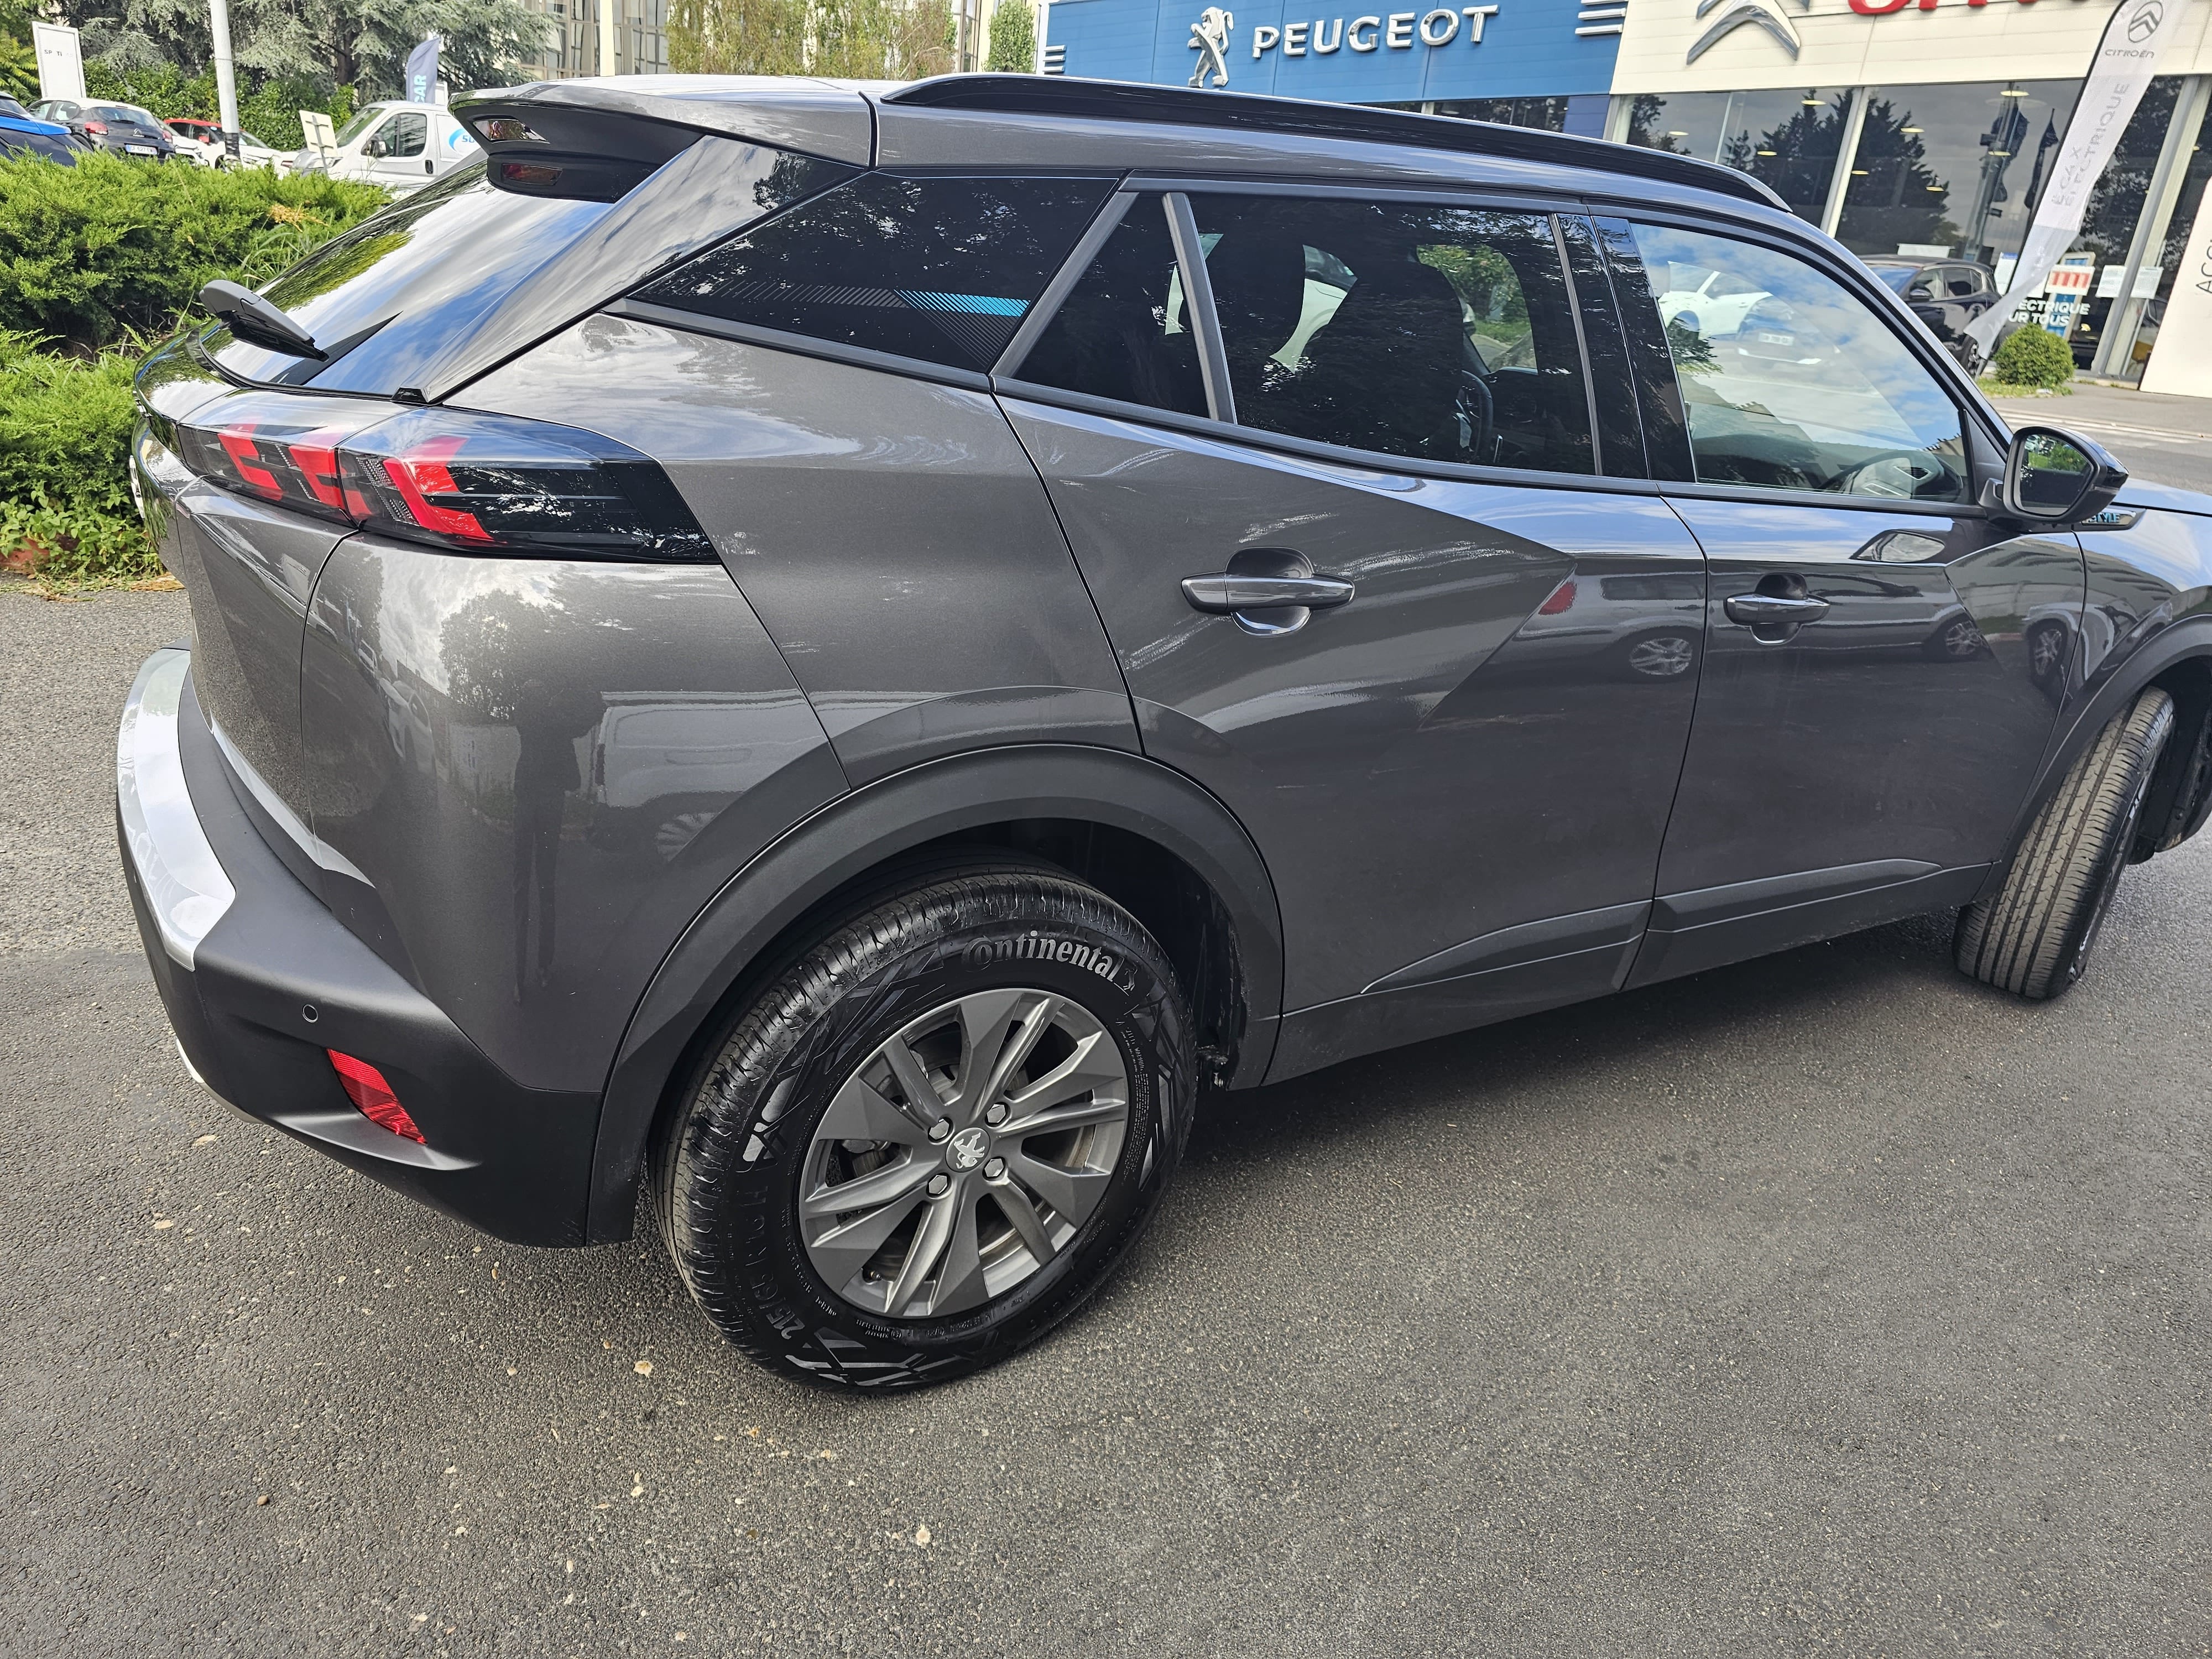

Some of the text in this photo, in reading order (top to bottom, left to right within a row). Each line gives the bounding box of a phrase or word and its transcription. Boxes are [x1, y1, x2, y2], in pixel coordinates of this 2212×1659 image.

[1252, 4, 1499, 58] PEUGEOT
[2032, 312, 2070, 326] TOUS
[962, 930, 1125, 982] Continental
